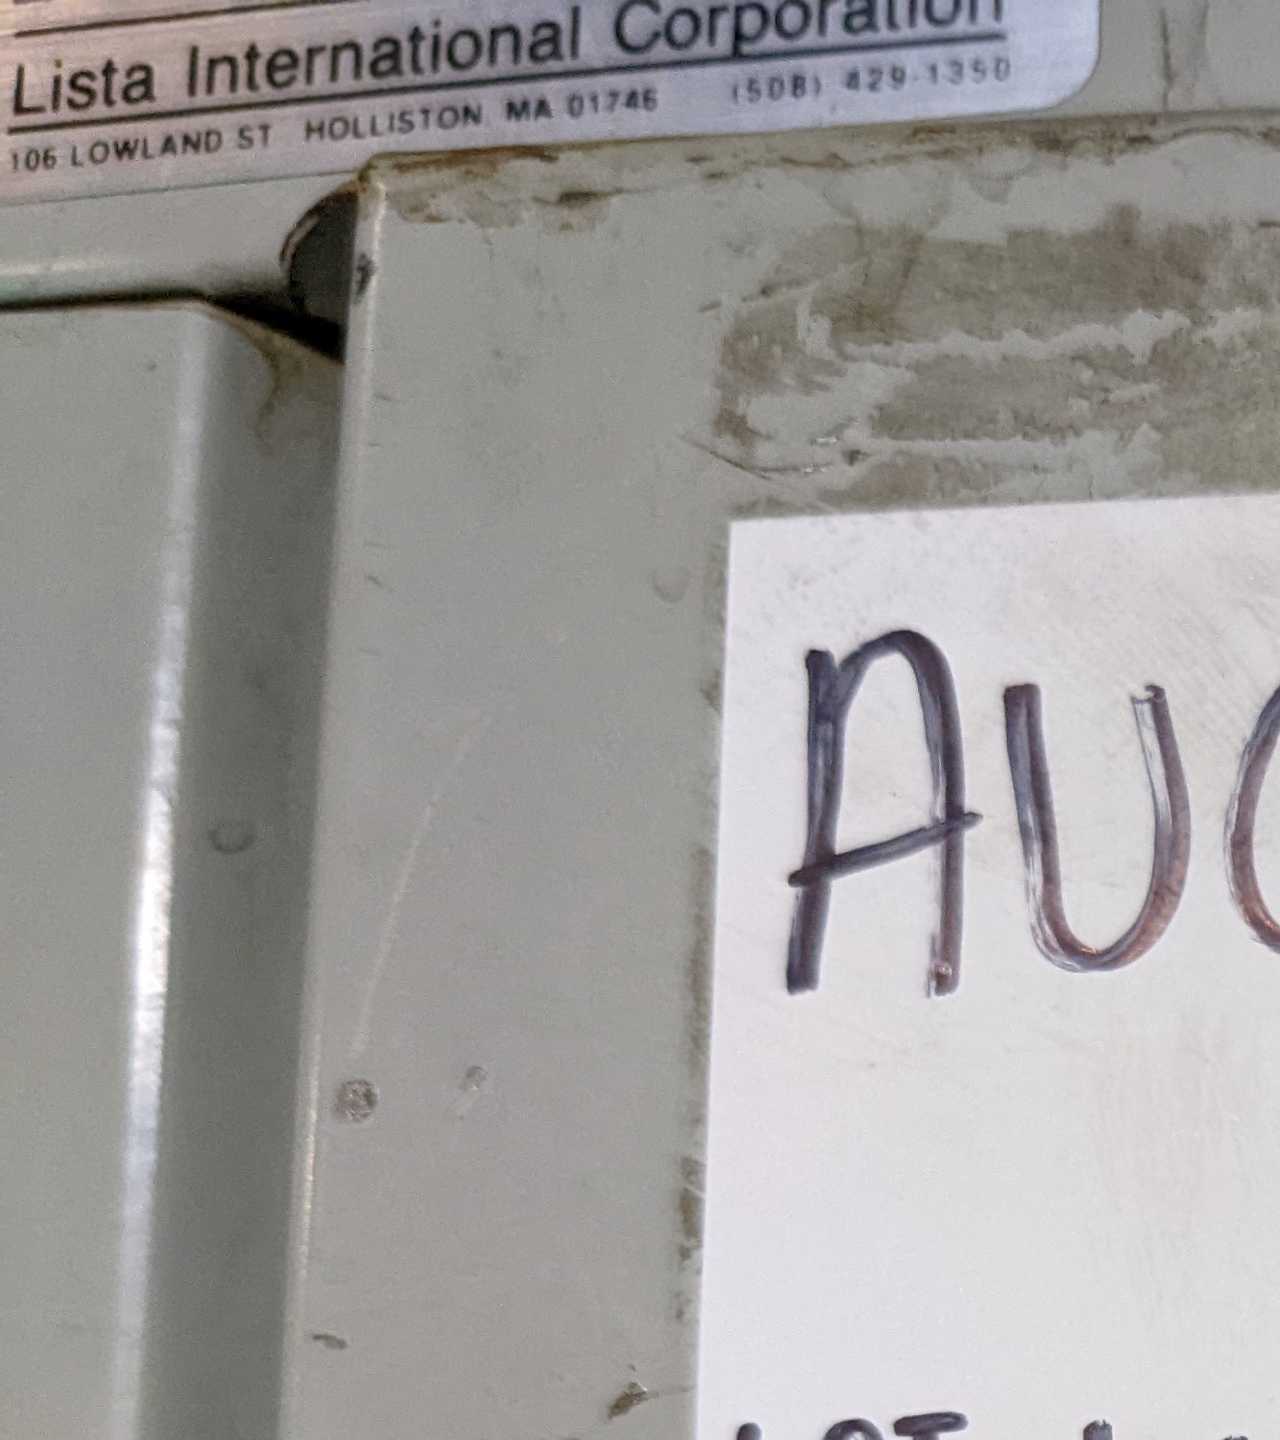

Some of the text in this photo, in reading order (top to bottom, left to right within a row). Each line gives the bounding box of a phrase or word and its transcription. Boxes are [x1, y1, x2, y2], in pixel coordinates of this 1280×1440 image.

[10, 57, 1011, 172] 106 LOWLAND ST HOLLISTON MA 01746 (508) 429-1350
[13, 0, 1003, 116] Lista International Corporation
